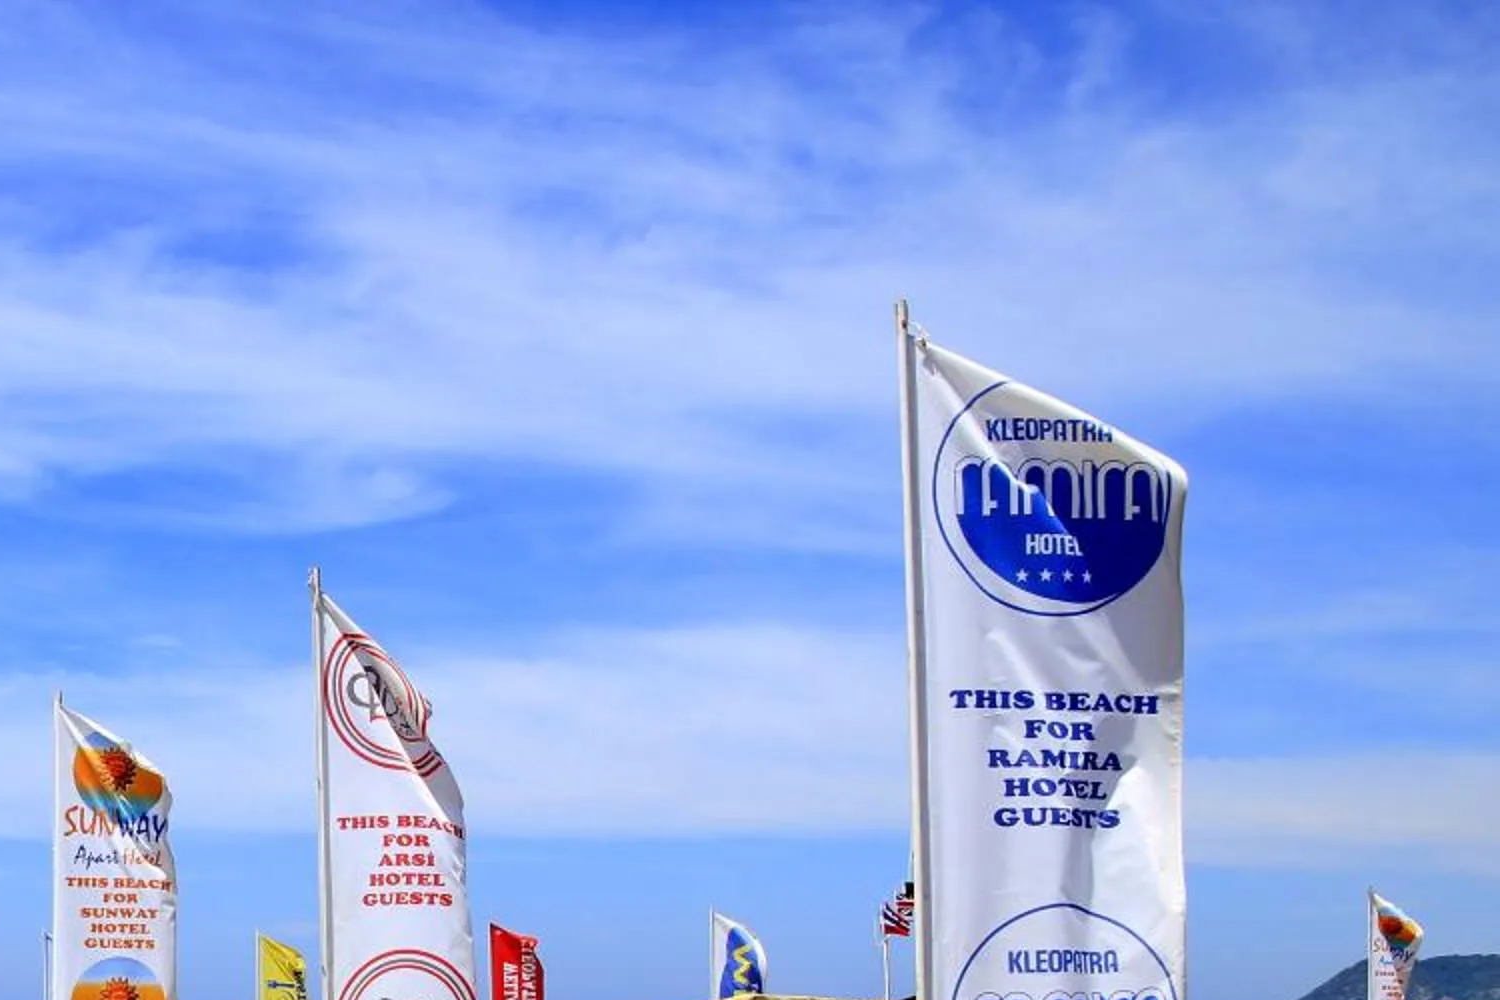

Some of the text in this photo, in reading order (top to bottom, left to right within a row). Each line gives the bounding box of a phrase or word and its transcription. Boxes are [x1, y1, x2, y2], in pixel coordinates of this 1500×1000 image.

[1025, 533, 1084, 557] HOTEL
[949, 689, 1160, 715] THIS BEACH
[1023, 719, 1095, 742] FOR
[987, 749, 1123, 772] RAMIRA
[1003, 777, 1108, 800] HOTEL
[63, 804, 168, 843] SUNWAY
[336, 815, 464, 839] THIS BEACH
[993, 807, 1122, 830] GUESTS
[382, 833, 431, 848] FOR
[65, 877, 174, 892] THIS BEACH
[368, 872, 446, 888] HOTEL
[102, 892, 139, 905] FOR
[361, 891, 454, 908] GUESTS
[80, 907, 160, 920] SUNWAY
[89, 922, 151, 935] HOTEL
[83, 937, 157, 950] GUESTS
[1007, 949, 1120, 975] KLEOPATRA
